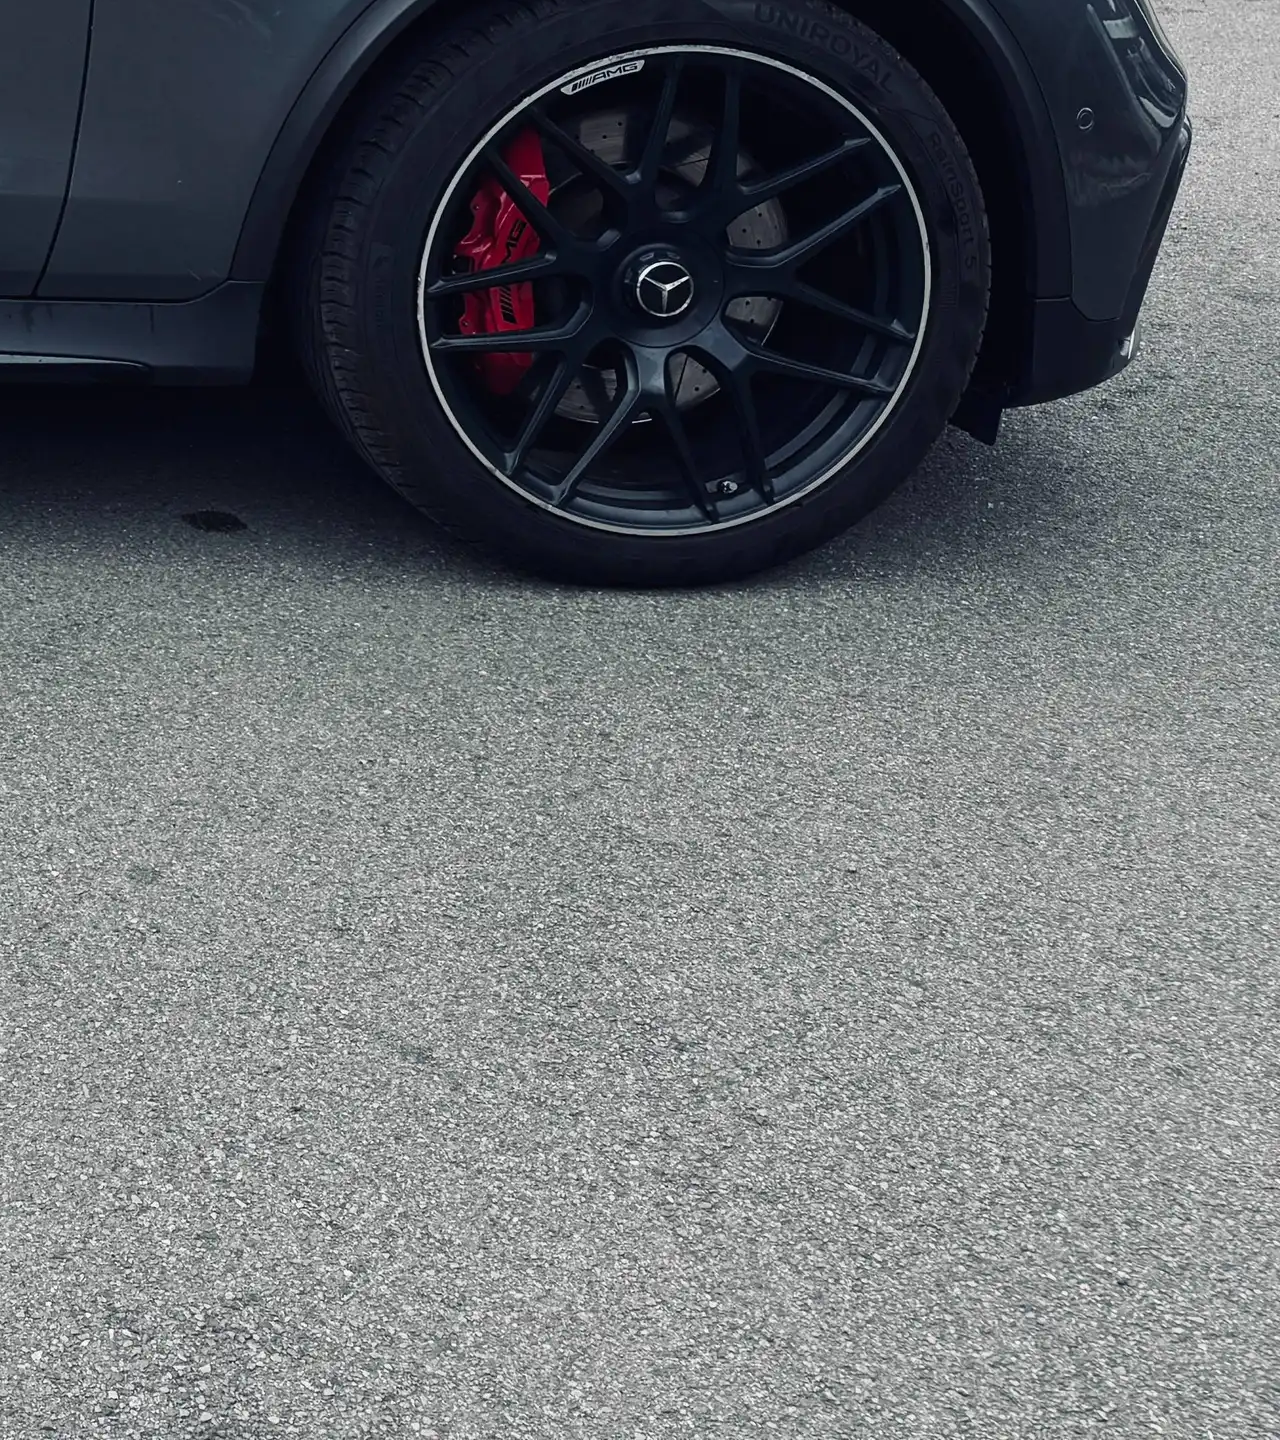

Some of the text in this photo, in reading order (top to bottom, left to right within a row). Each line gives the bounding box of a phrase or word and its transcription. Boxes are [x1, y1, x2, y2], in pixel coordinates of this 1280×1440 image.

[754, 3, 893, 94] UNIROYAL
[927, 131, 977, 271] RainSport 5
